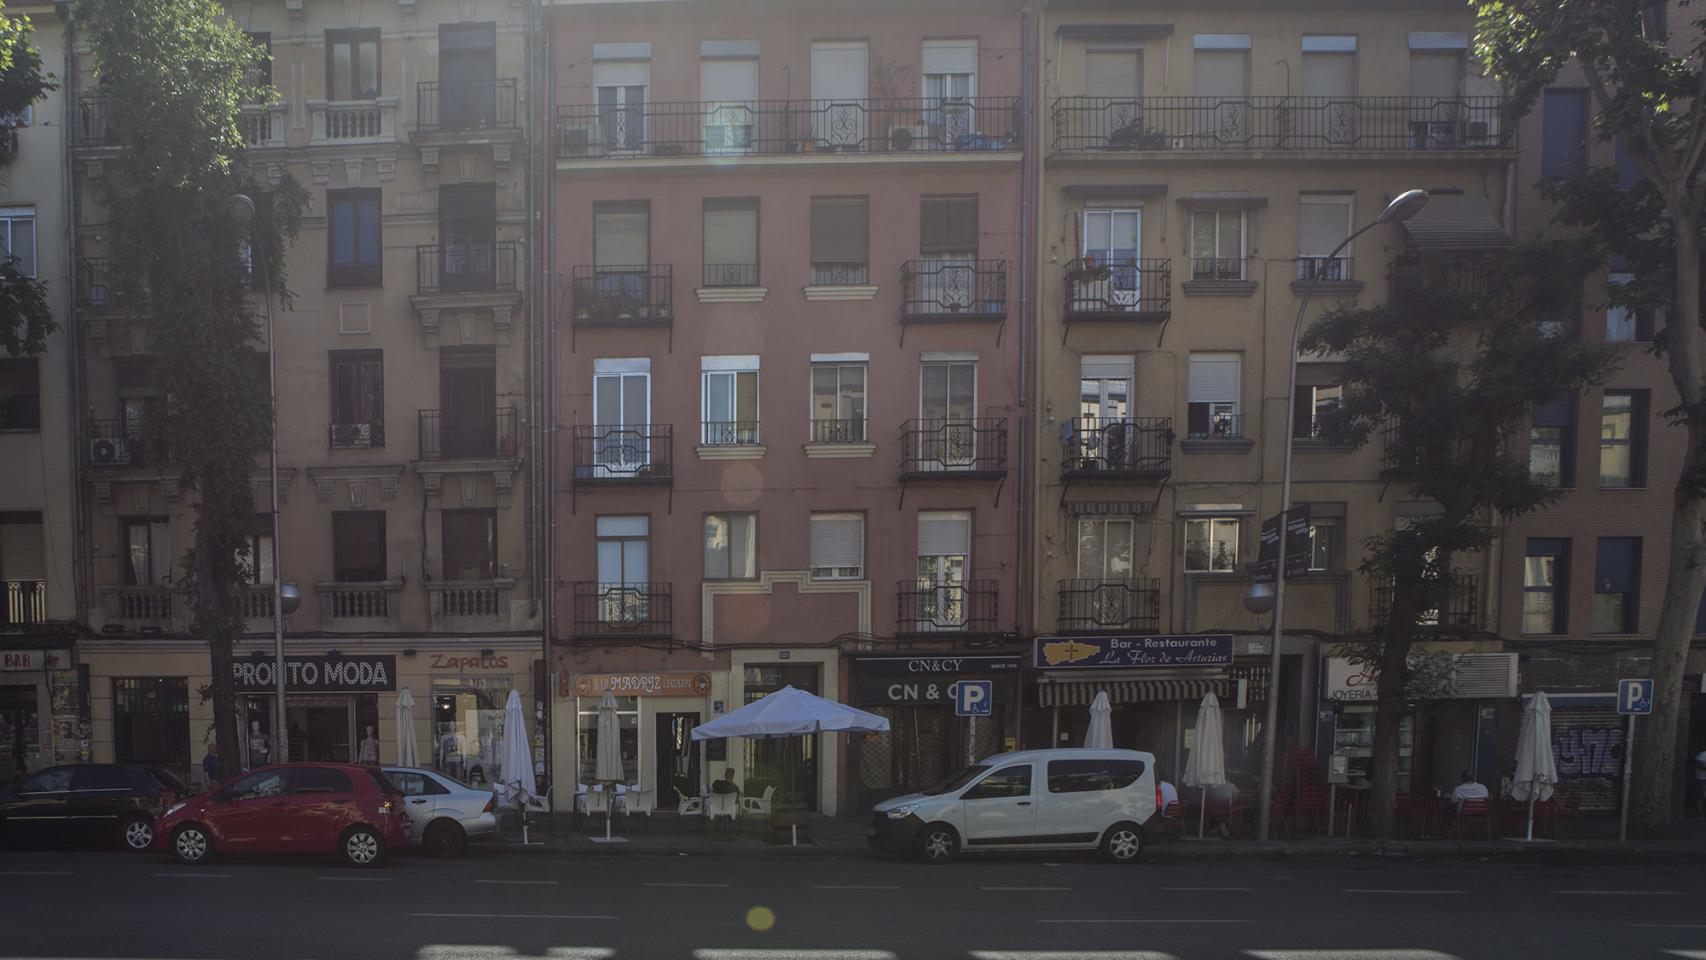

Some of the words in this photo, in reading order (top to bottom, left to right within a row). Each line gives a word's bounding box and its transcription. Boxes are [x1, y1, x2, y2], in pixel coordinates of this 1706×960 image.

[1110, 638, 1132, 648] Bar
[1145, 638, 1216, 648] Restaurante
[4, 653, 32, 668] BAR
[430, 654, 509, 674] Zapatos
[1099, 651, 1120, 664] La
[1127, 650, 1158, 664] Flor
[1159, 652, 1172, 662] de
[1173, 650, 1227, 664] Asturias
[324, 661, 388, 686] MODA
[908, 659, 962, 672] CN&CY
[887, 683, 919, 701] CN
[925, 683, 940, 701] &
[963, 685, 984, 711] P
[1329, 686, 1372, 700] JOYERÍA
[1627, 682, 1643, 710] P
